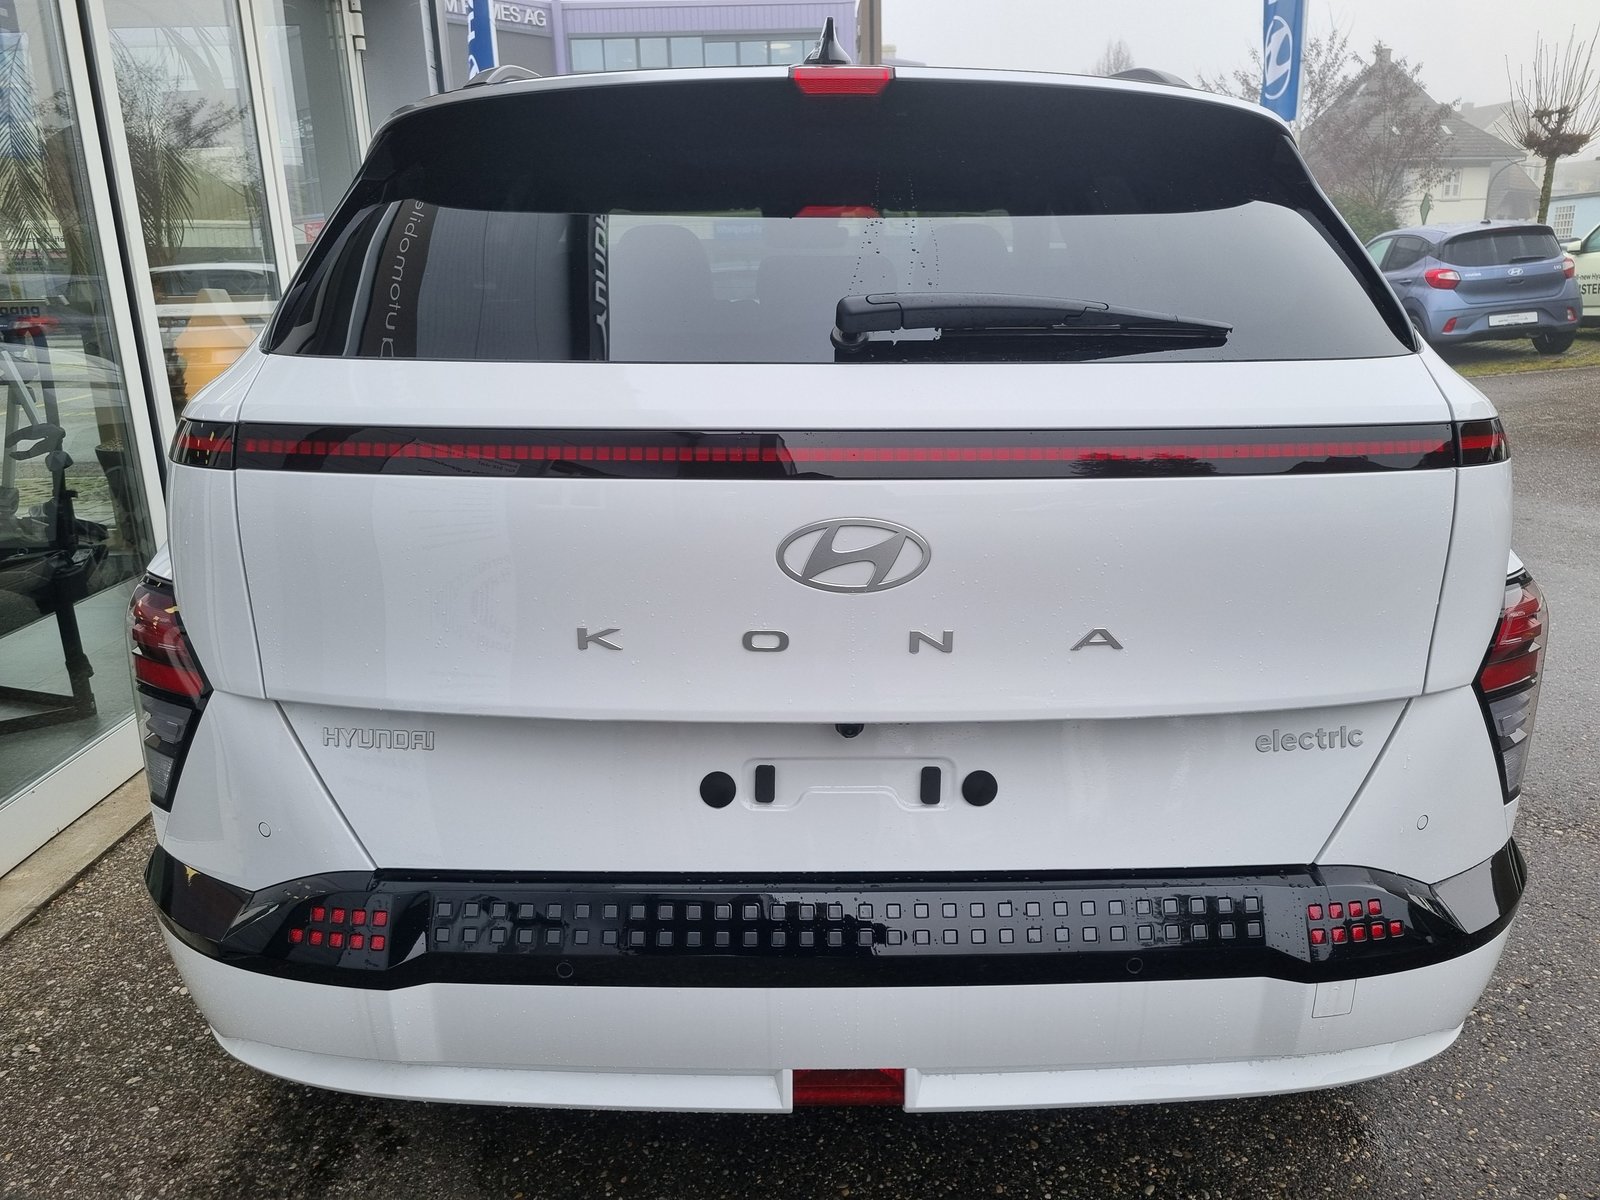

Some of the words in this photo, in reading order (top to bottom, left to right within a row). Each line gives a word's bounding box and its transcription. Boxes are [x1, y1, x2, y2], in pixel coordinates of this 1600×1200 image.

[524, 9, 546, 26] AG
[576, 626, 1124, 654] KONA
[322, 727, 435, 751] HYUNDAI
[1255, 725, 1364, 753] electric
